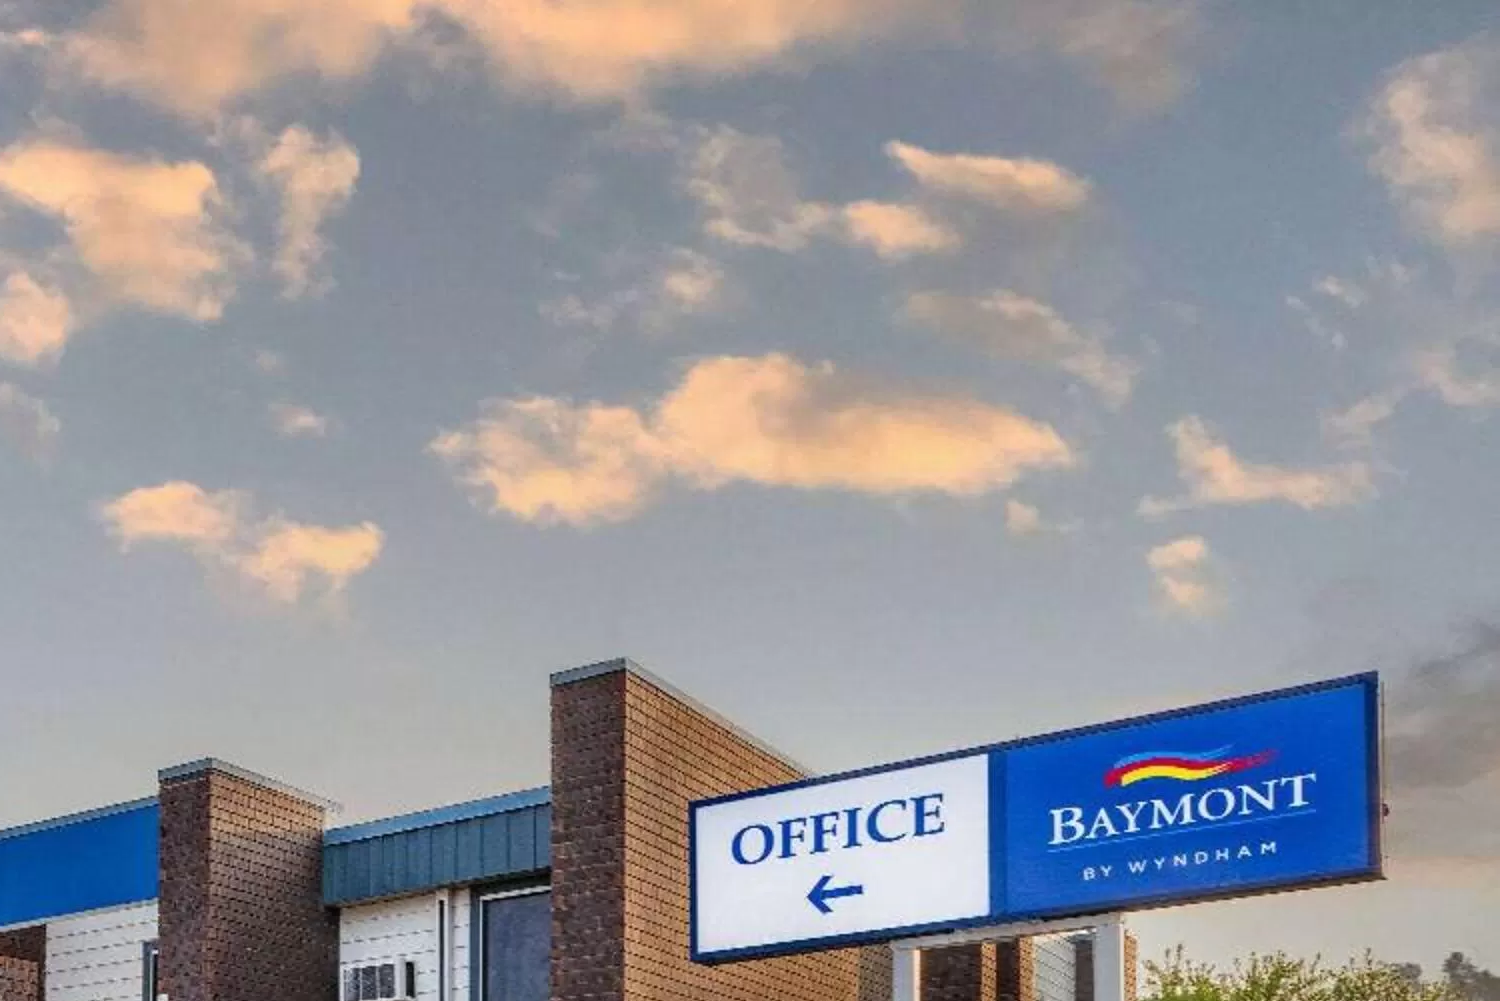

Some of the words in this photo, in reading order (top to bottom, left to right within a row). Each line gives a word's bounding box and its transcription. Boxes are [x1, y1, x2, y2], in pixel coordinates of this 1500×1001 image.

[732, 794, 945, 865] OFFICE
[1048, 773, 1317, 845] BAYMONT
[1083, 865, 1113, 881] BY
[1129, 841, 1277, 874] WYNDHAM
